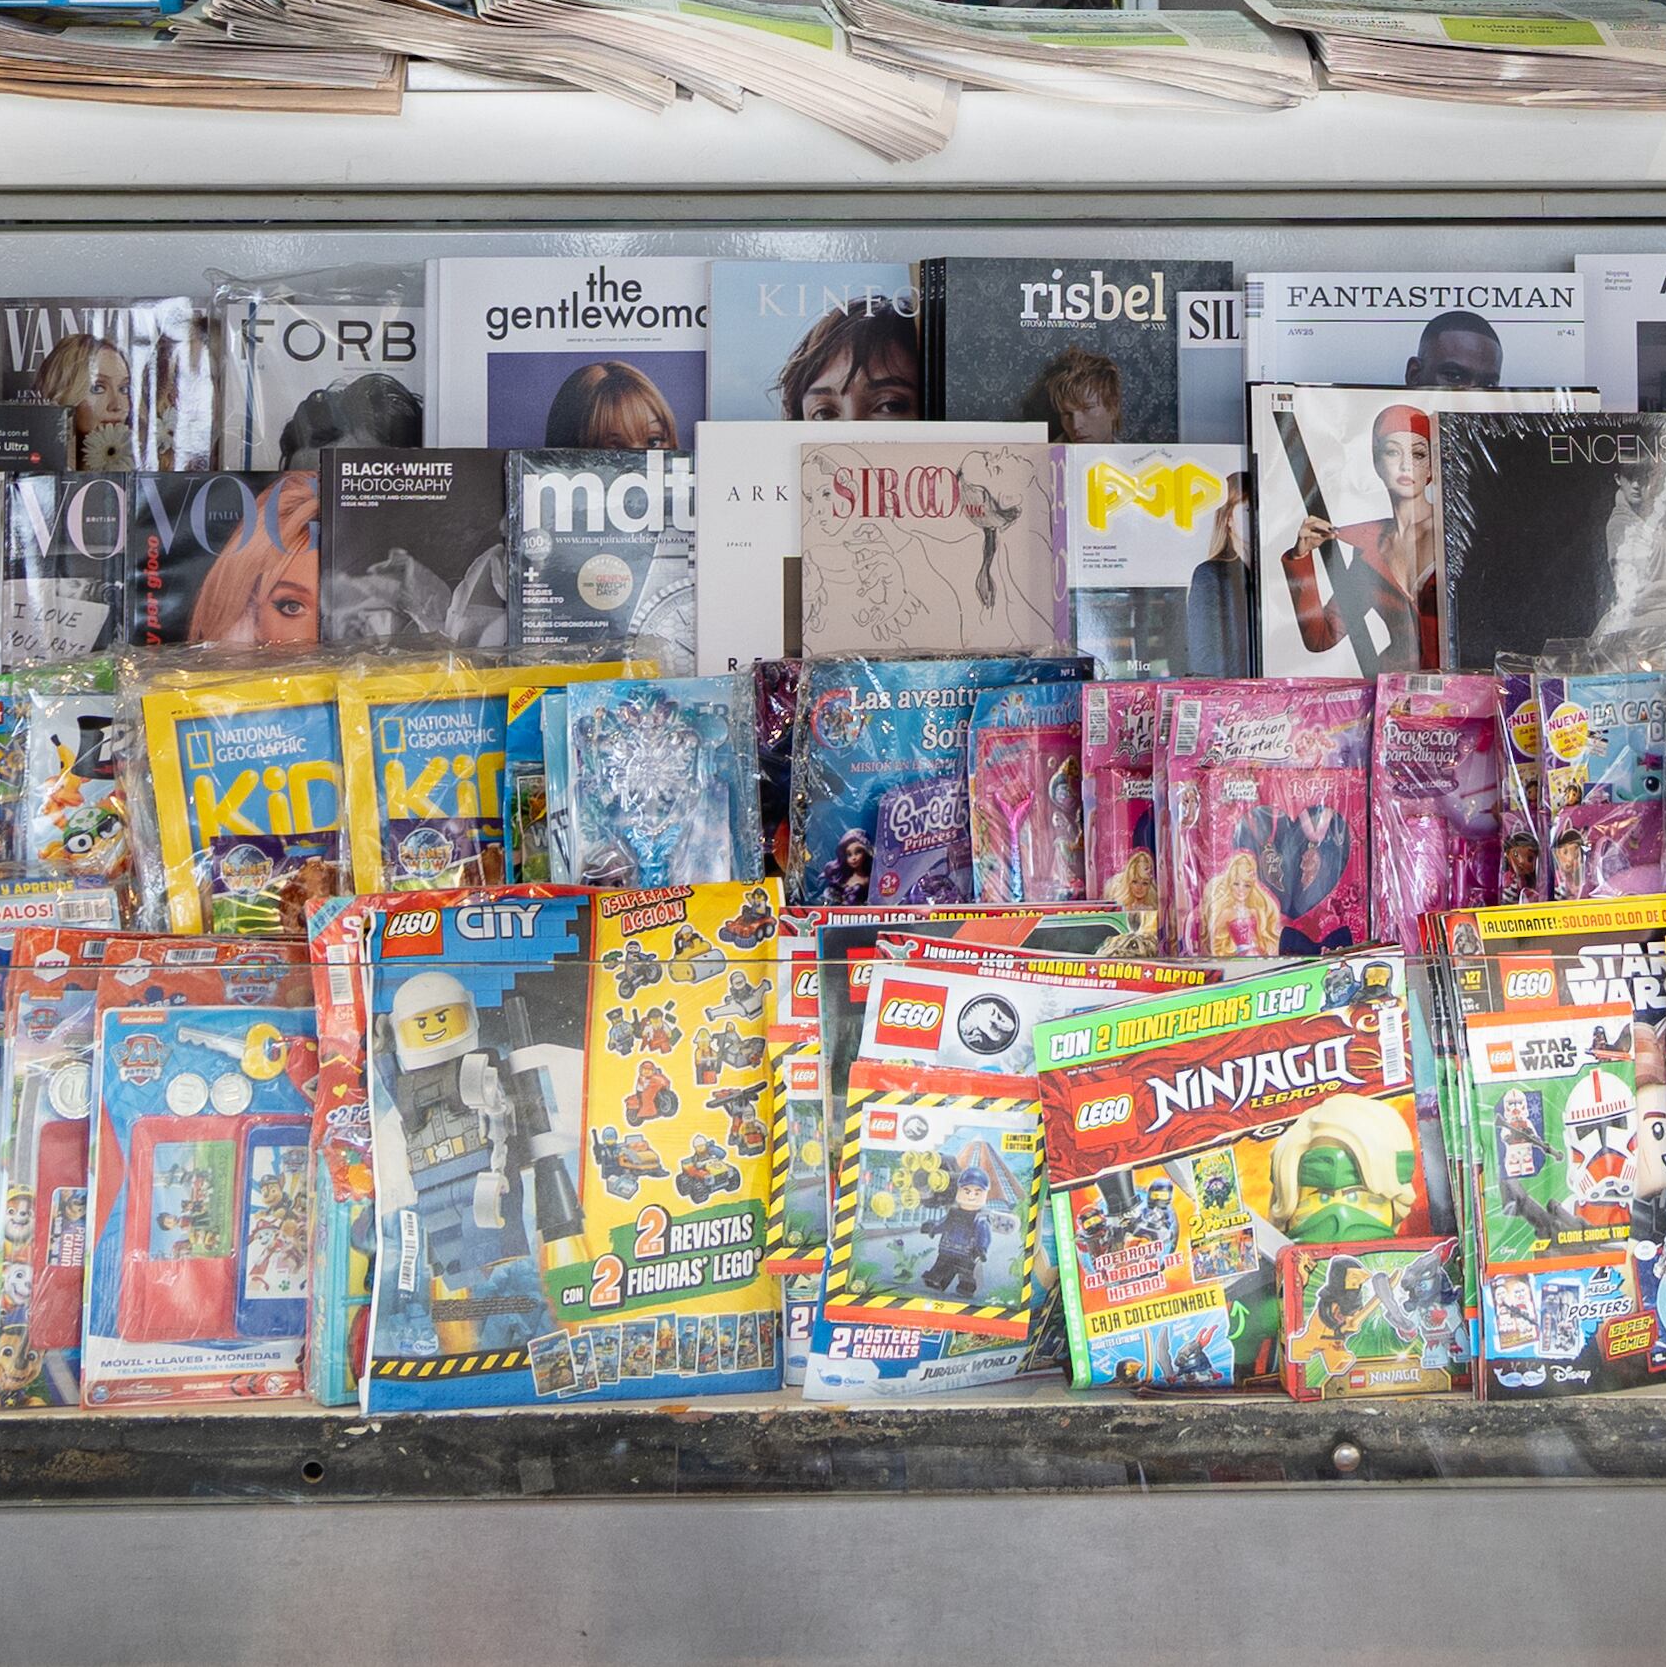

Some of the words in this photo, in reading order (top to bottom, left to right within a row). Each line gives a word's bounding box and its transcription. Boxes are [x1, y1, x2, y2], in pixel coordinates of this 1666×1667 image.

[1021, 269, 1167, 322] risbel
[1287, 285, 1573, 309] FANTASTICMAN
[342, 463, 453, 476] BLACK+WHITE
[341, 478, 453, 493] PHOTOGRAPHY
[407, 715, 477, 730] NATIONAL
[408, 729, 496, 748] GEOGRAPHIC
[387, 910, 437, 937] LEGO
[883, 997, 941, 1031] LEGO
[1520, 1037, 1577, 1056] STAR
[1521, 1052, 1577, 1073] WARS
[1075, 1095, 1131, 1130] LEGO
[1569, 1299, 1631, 1319] POSTERS
